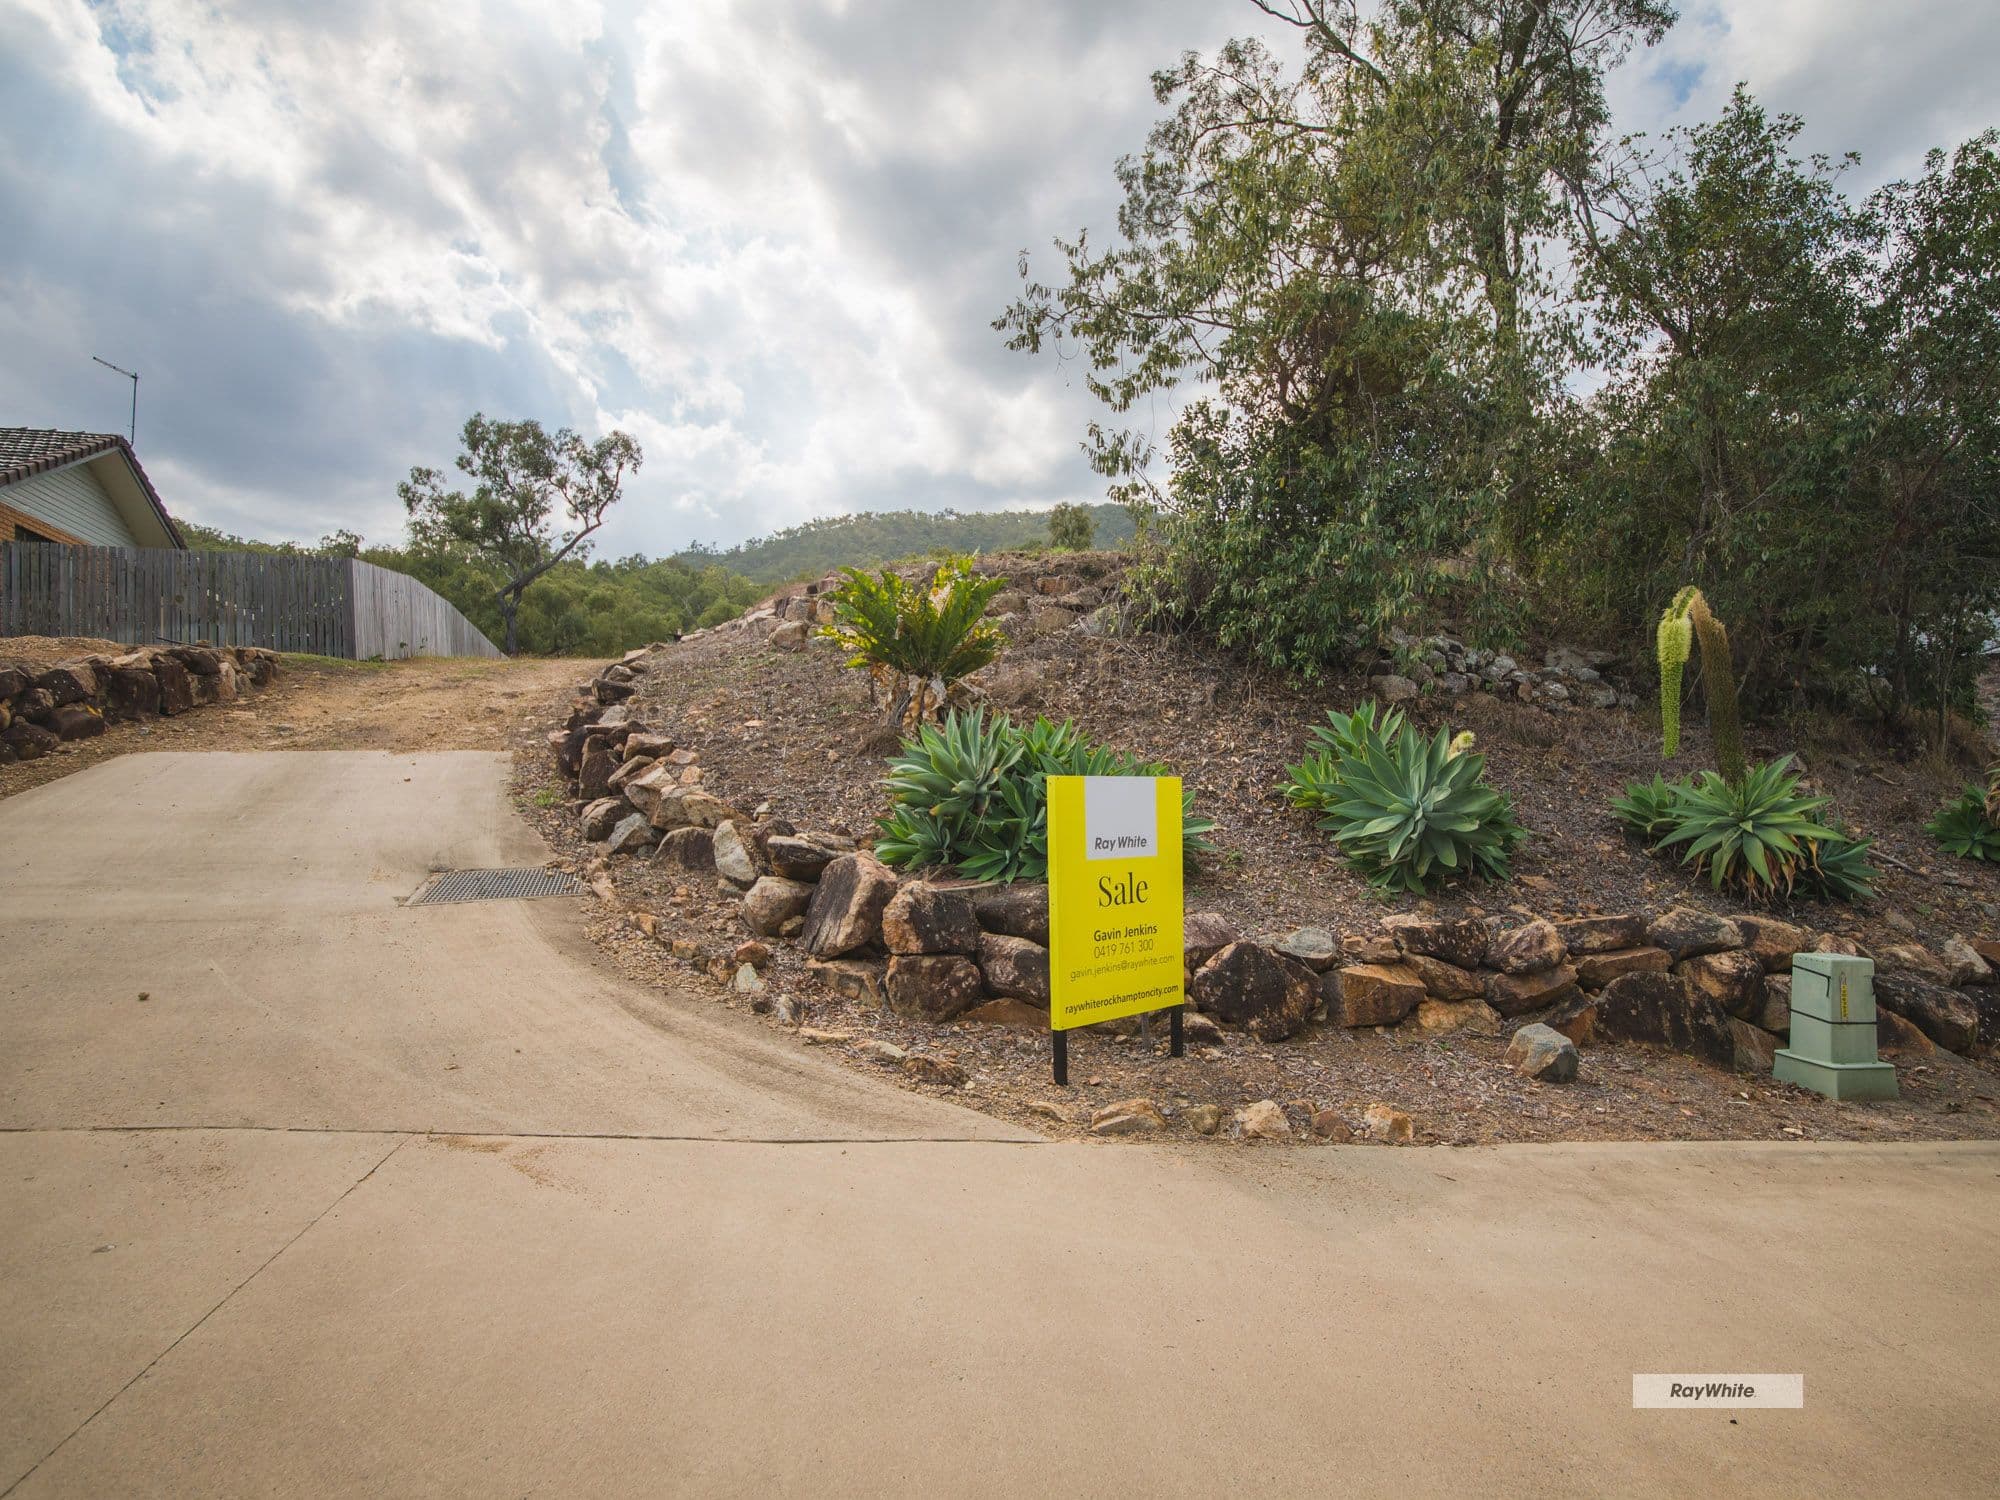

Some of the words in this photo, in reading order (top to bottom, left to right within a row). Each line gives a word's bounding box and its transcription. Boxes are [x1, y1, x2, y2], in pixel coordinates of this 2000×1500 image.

[1095, 837, 1117, 851] Ray
[1117, 835, 1147, 849] White
[1098, 872, 1148, 908] Sale
[1093, 928, 1121, 942] Gavin
[1124, 924, 1157, 938] Jenkins
[1094, 944, 1117, 959] 0419
[1119, 942, 1135, 955] 761
[1138, 938, 1154, 951] 300
[1070, 954, 1175, 982] gavin.jenkins@raywhite.com
[1065, 984, 1179, 1015] raywhiterockhamptoncity.com
